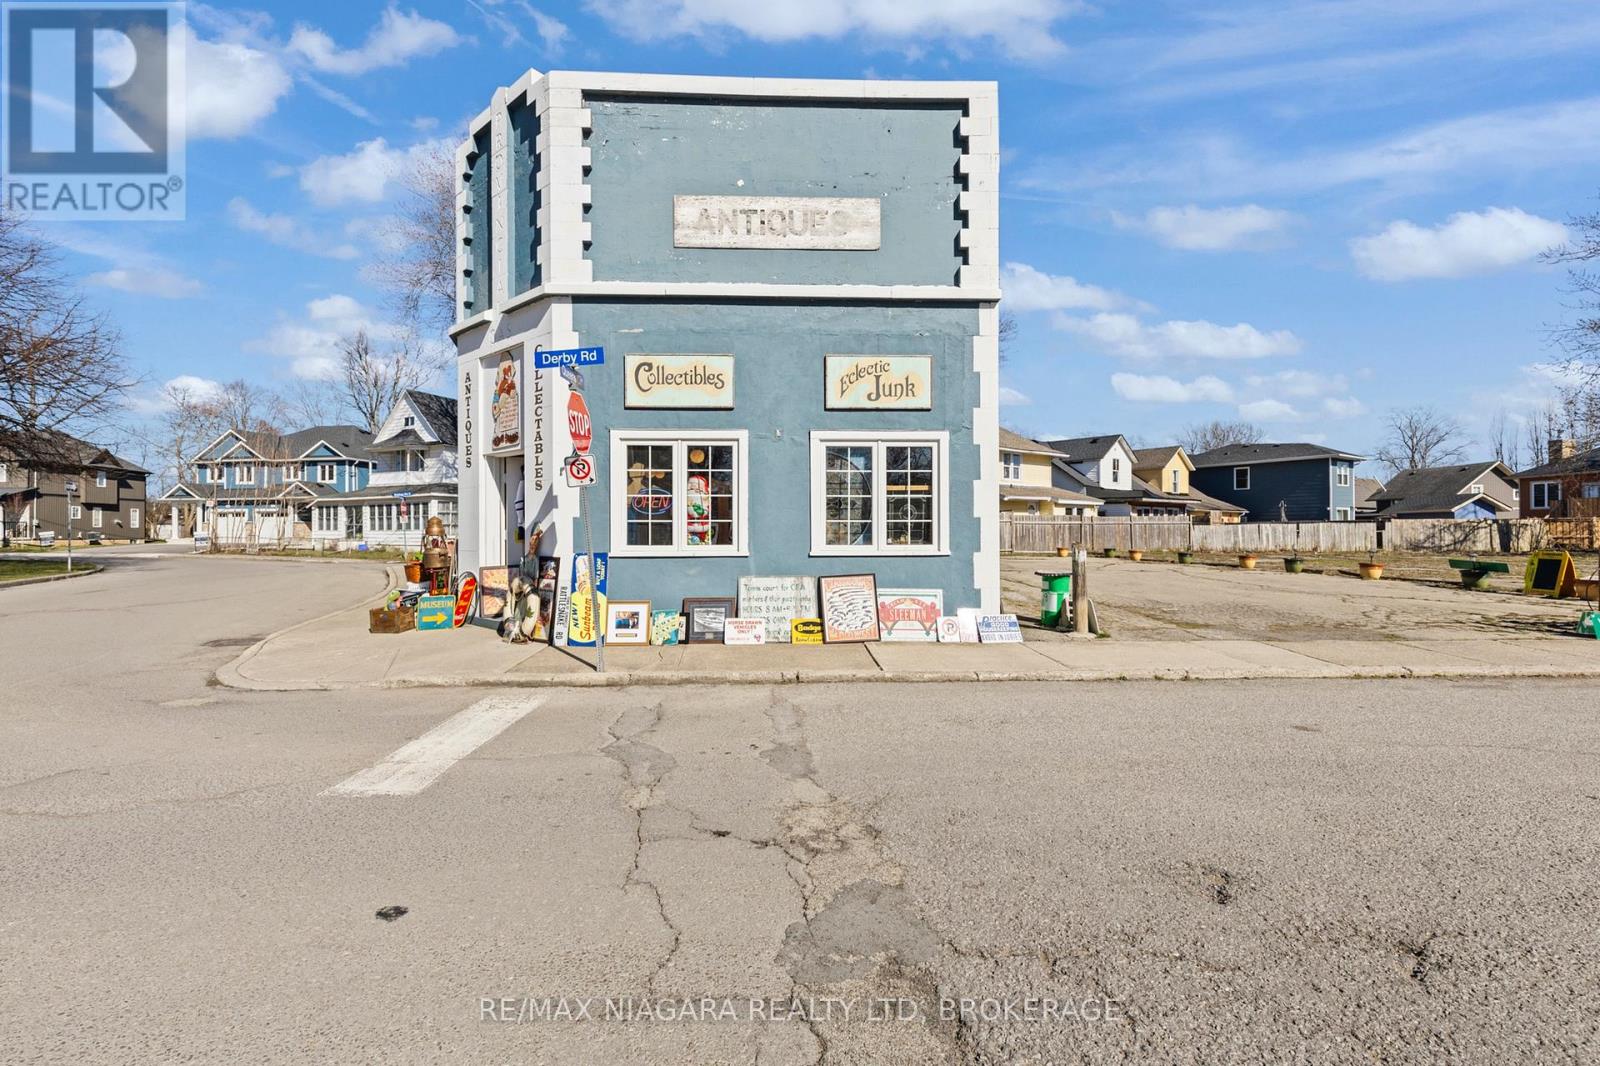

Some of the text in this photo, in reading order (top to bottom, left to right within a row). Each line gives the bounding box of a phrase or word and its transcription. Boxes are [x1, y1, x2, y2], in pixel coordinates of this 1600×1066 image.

[542, 350, 597, 365] Derby Rd
[634, 362, 725, 392] Collectibles
[839, 360, 890, 398] Eclectic
[866, 374, 916, 401] Junk
[464, 372, 472, 469] ANTIQUES
[534, 344, 543, 491] CLLECTABLES
[569, 410, 590, 436] STOP
[633, 496, 669, 508] OPEN
[420, 600, 454, 609] MUSEUM
[555, 586, 568, 640] RATTLESNAKE RD
[889, 608, 927, 621] SLEEMAN
[580, 597, 592, 641] Sunbeam
